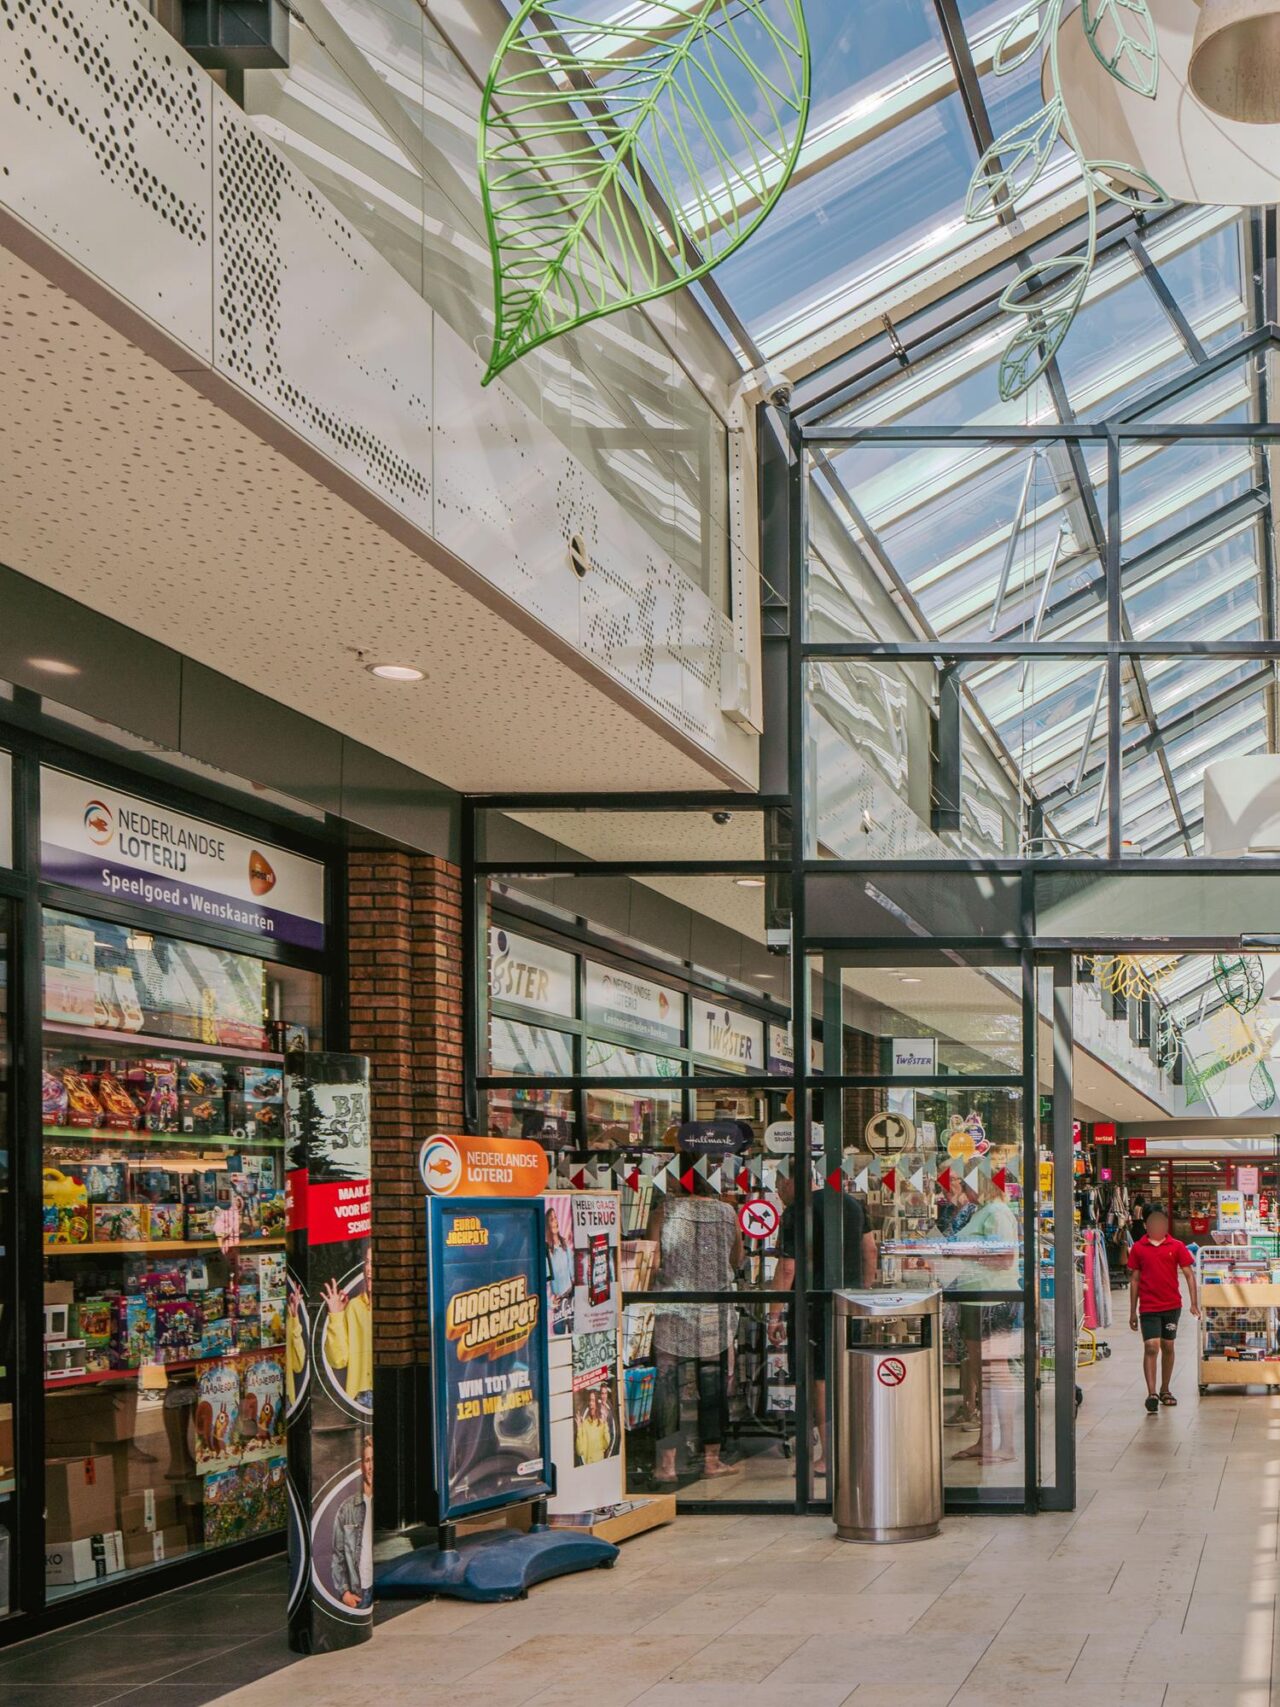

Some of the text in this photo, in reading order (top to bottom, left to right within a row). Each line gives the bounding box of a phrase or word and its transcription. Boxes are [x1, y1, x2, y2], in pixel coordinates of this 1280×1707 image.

[118, 807, 226, 861] NEDERLANDSE
[119, 833, 187, 873] LOTERIJ
[101, 868, 275, 932] Speelgoed Wenskaarten
[684, 1133, 736, 1147] Hallmark
[466, 1151, 538, 1168] NEDERLANDSE
[467, 1167, 513, 1183] LOTERIJ
[333, 1204, 360, 1218] VOOR
[575, 1200, 616, 1210] HELEN GRACE
[453, 1217, 478, 1231] EURO
[576, 1210, 616, 1227] IS TERUG
[446, 1230, 487, 1246] JACKPOT
[453, 1276, 526, 1325] HOOGSTE
[465, 1297, 538, 1348] JACKPOT
[458, 1378, 484, 1400] WIN
[485, 1373, 508, 1392] TOT
[456, 1400, 480, 1421] 120
